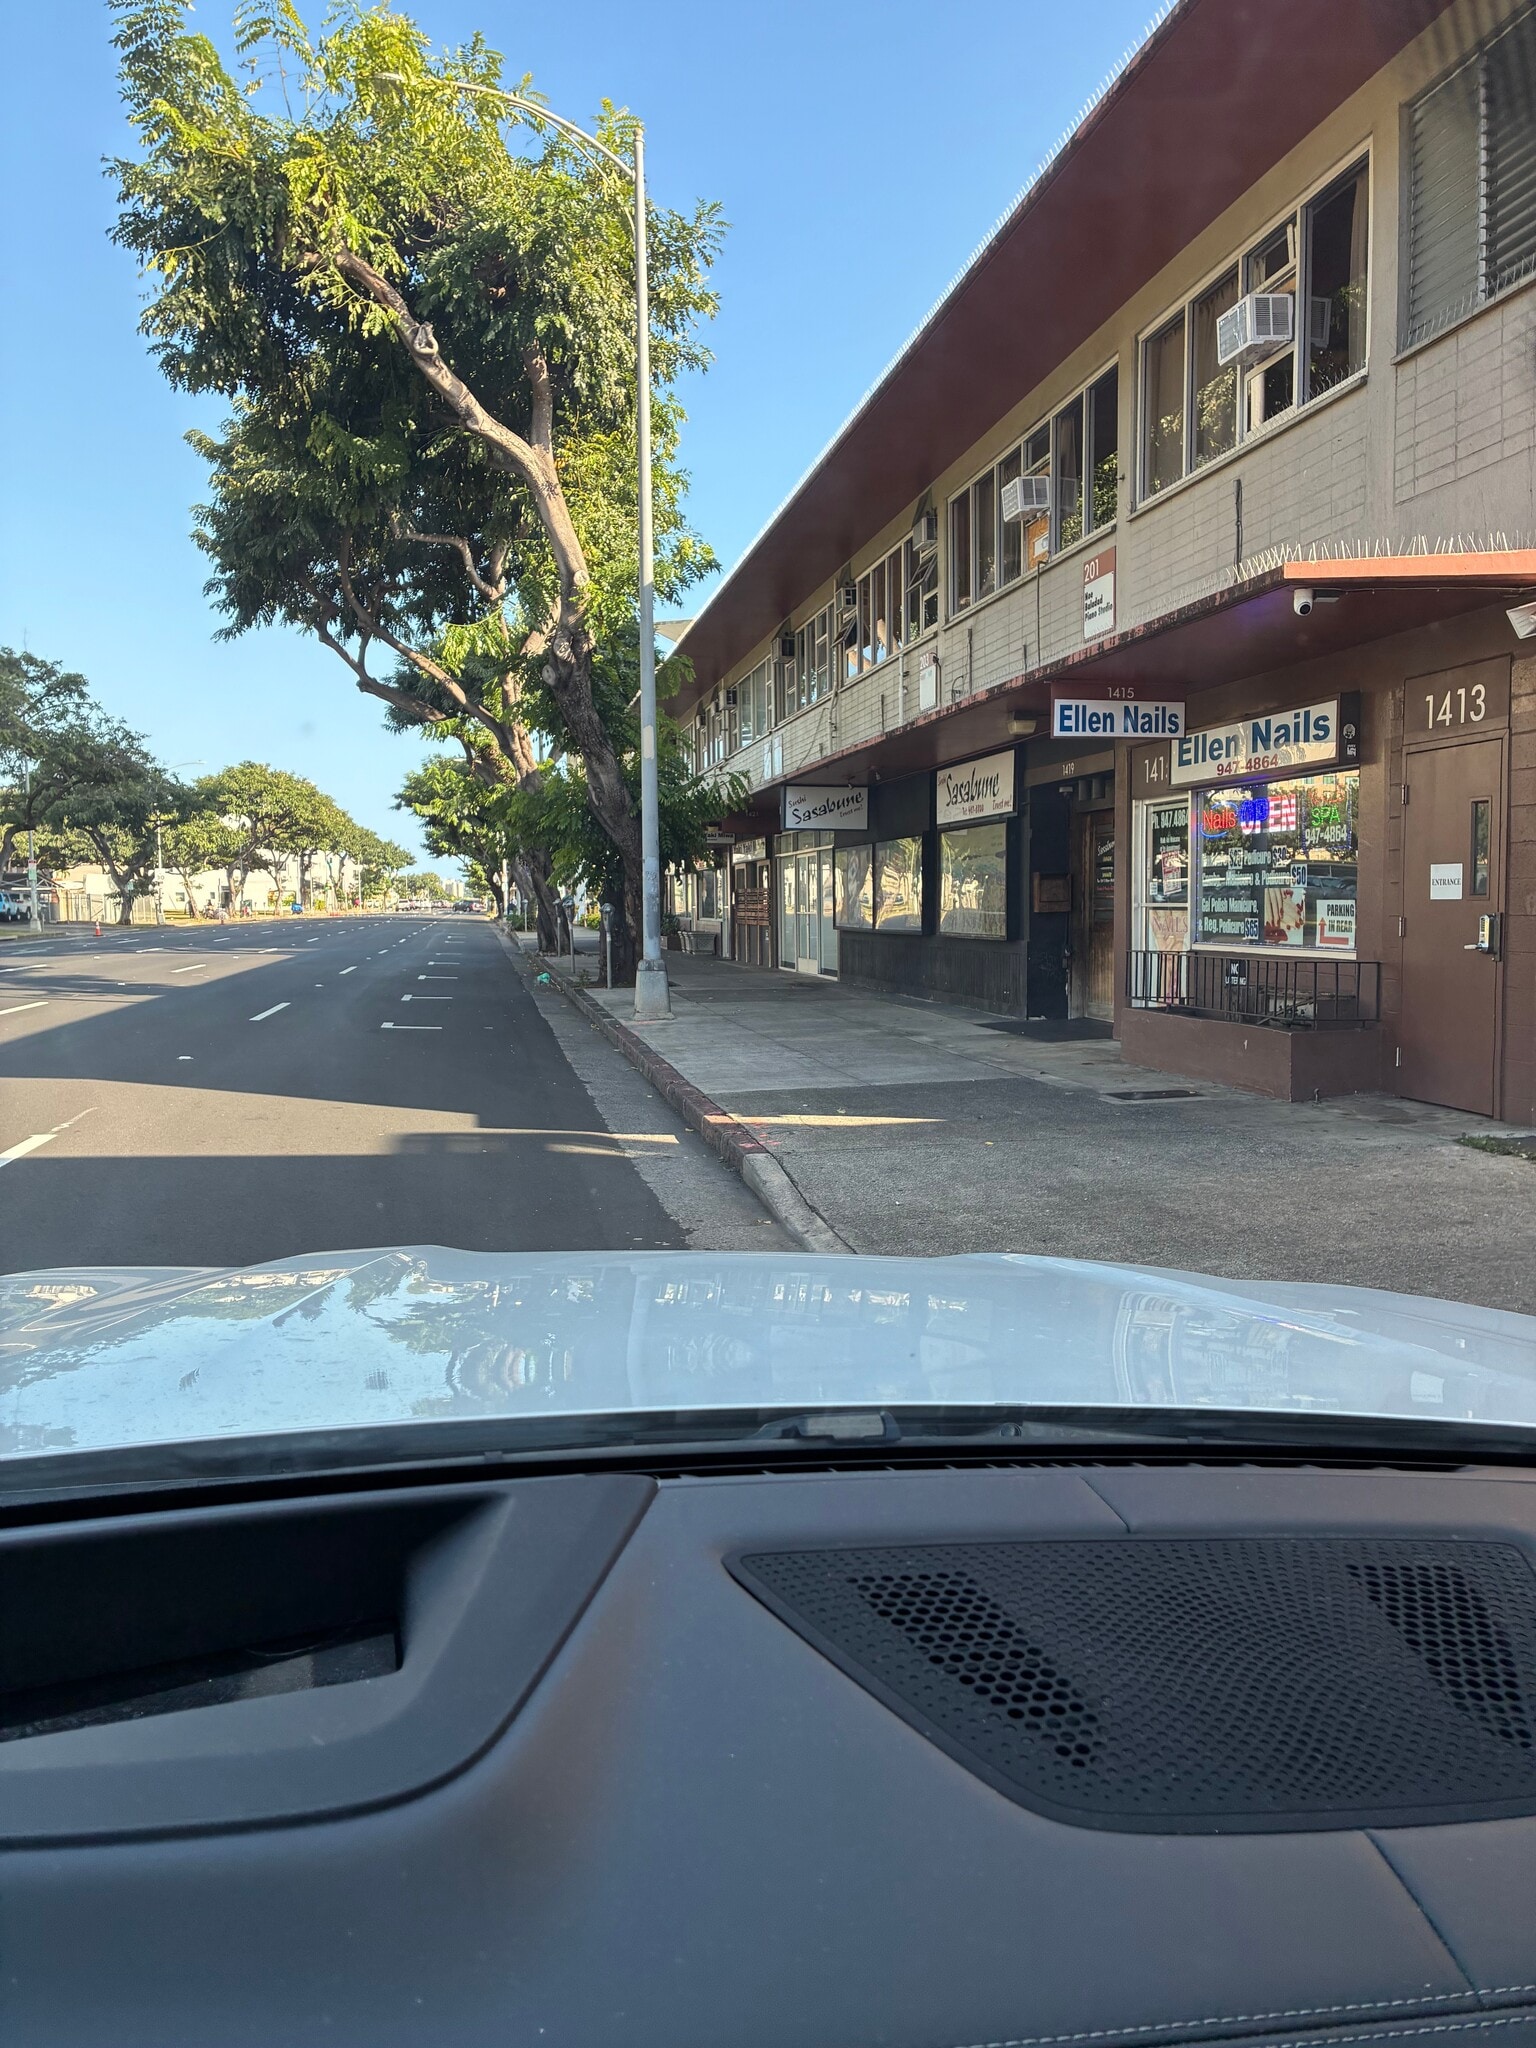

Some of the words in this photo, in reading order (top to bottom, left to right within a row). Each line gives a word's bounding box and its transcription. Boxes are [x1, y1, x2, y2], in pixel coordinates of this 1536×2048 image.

[1084, 558, 1099, 582] 201
[1085, 611, 1097, 622] Piano
[1098, 602, 1112, 616] Studio
[1107, 687, 1134, 699] 1415
[1425, 683, 1486, 729] 1413
[1059, 704, 1115, 733] Ellen
[1123, 705, 1180, 734] Nails
[1177, 733, 1239, 768] Ellen
[1252, 709, 1331, 753] Nails
[1062, 762, 1075, 776] 1419
[1144, 756, 1169, 784] 141
[1216, 753, 1279, 776] 947-4864
[945, 767, 1000, 807] Sasabune
[788, 794, 807, 809] Sushi
[791, 792, 864, 825] Sasabune
[1202, 807, 1237, 830] Nails
[1238, 794, 1296, 835] OPEN
[1311, 804, 1341, 827] SPA
[1304, 824, 1348, 847] 947-4864
[1244, 850, 1272, 865] Pedicure
[1255, 871, 1260, 885] &
[1261, 869, 1290, 886] Pedicure
[1291, 866, 1306, 886] $50
[1431, 877, 1461, 886] ENTRANCE
[1202, 898, 1211, 912] Gel
[1212, 898, 1228, 913] Polish
[1326, 903, 1355, 917] PARKING
[1152, 914, 1189, 933] NAILS
[1204, 917, 1219, 933] Reg.
[1219, 919, 1244, 934] Pedicure
[1245, 918, 1258, 937] $65
[1328, 919, 1335, 932] IN
[1336, 919, 1353, 933] REAR
